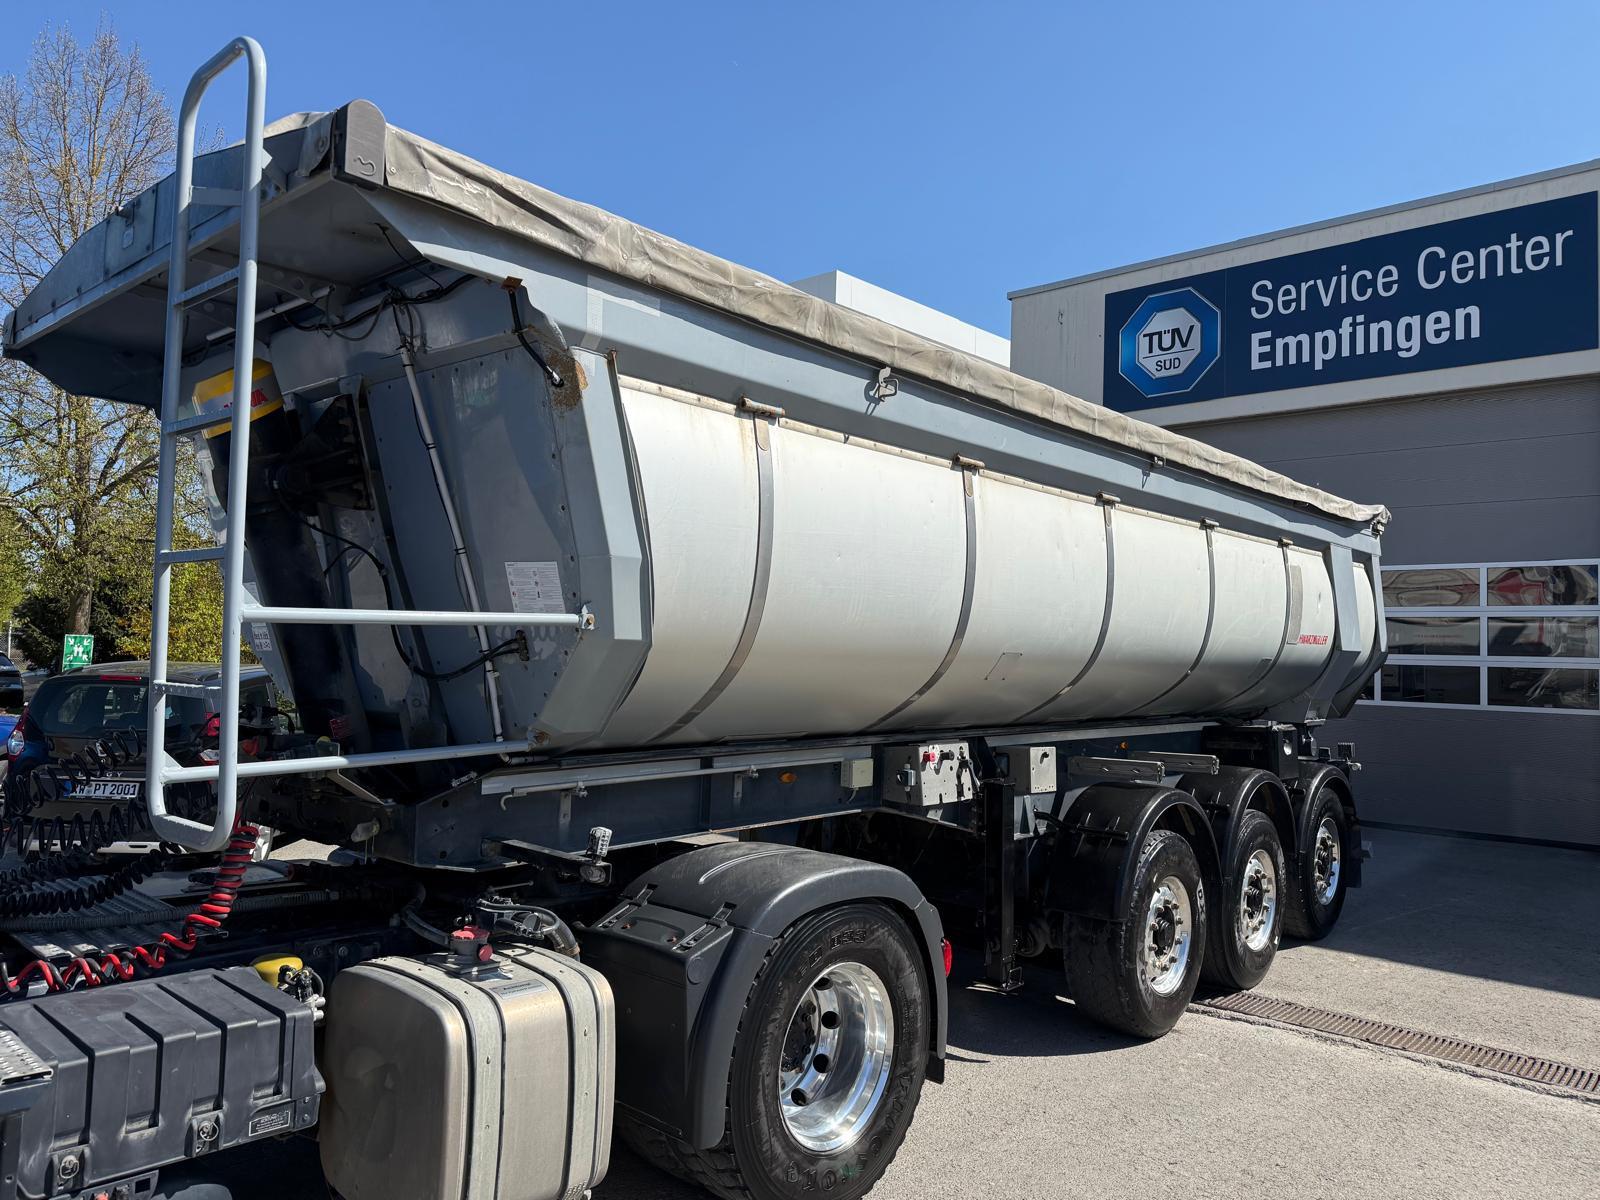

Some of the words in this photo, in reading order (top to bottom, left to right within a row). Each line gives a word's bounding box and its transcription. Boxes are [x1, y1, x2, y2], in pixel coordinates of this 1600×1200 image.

[1250, 264, 1399, 320] Service
[1417, 229, 1573, 290] Center
[1142, 323, 1196, 354] TÜV
[1250, 304, 1481, 370] Empfingen
[1154, 356, 1182, 373] SÜD
[93, 783, 108, 795] PT
[109, 783, 137, 796] 2001
